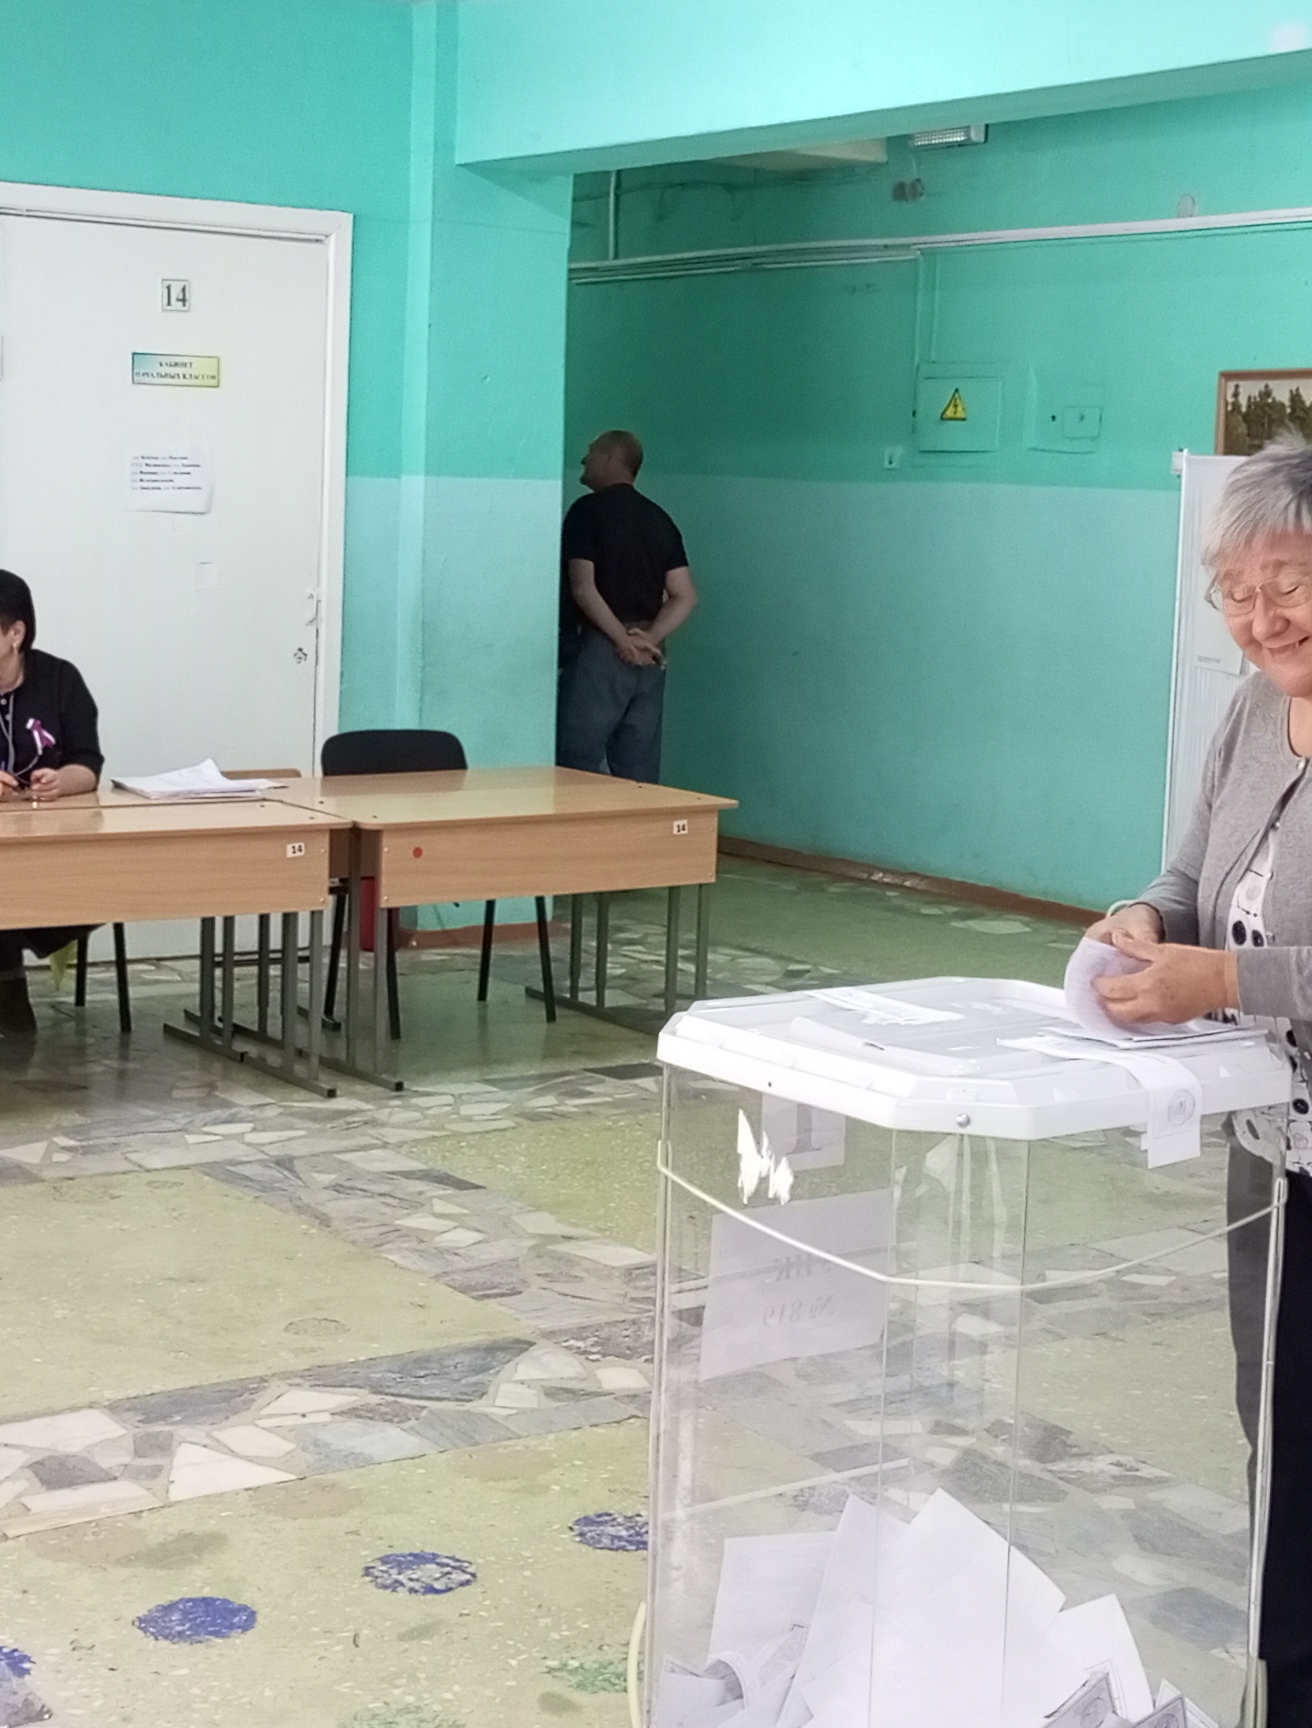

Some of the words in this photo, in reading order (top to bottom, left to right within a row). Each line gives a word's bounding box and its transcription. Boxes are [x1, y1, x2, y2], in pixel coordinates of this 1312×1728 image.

[165, 283, 188, 308] 14
[158, 361, 194, 369] КАБИНЕТ
[134, 371, 181, 380] НАЧАЛЬНЫХ
[182, 373, 218, 381] КЛАССОВ
[676, 823, 687, 833] 14
[291, 844, 303, 855] 14
